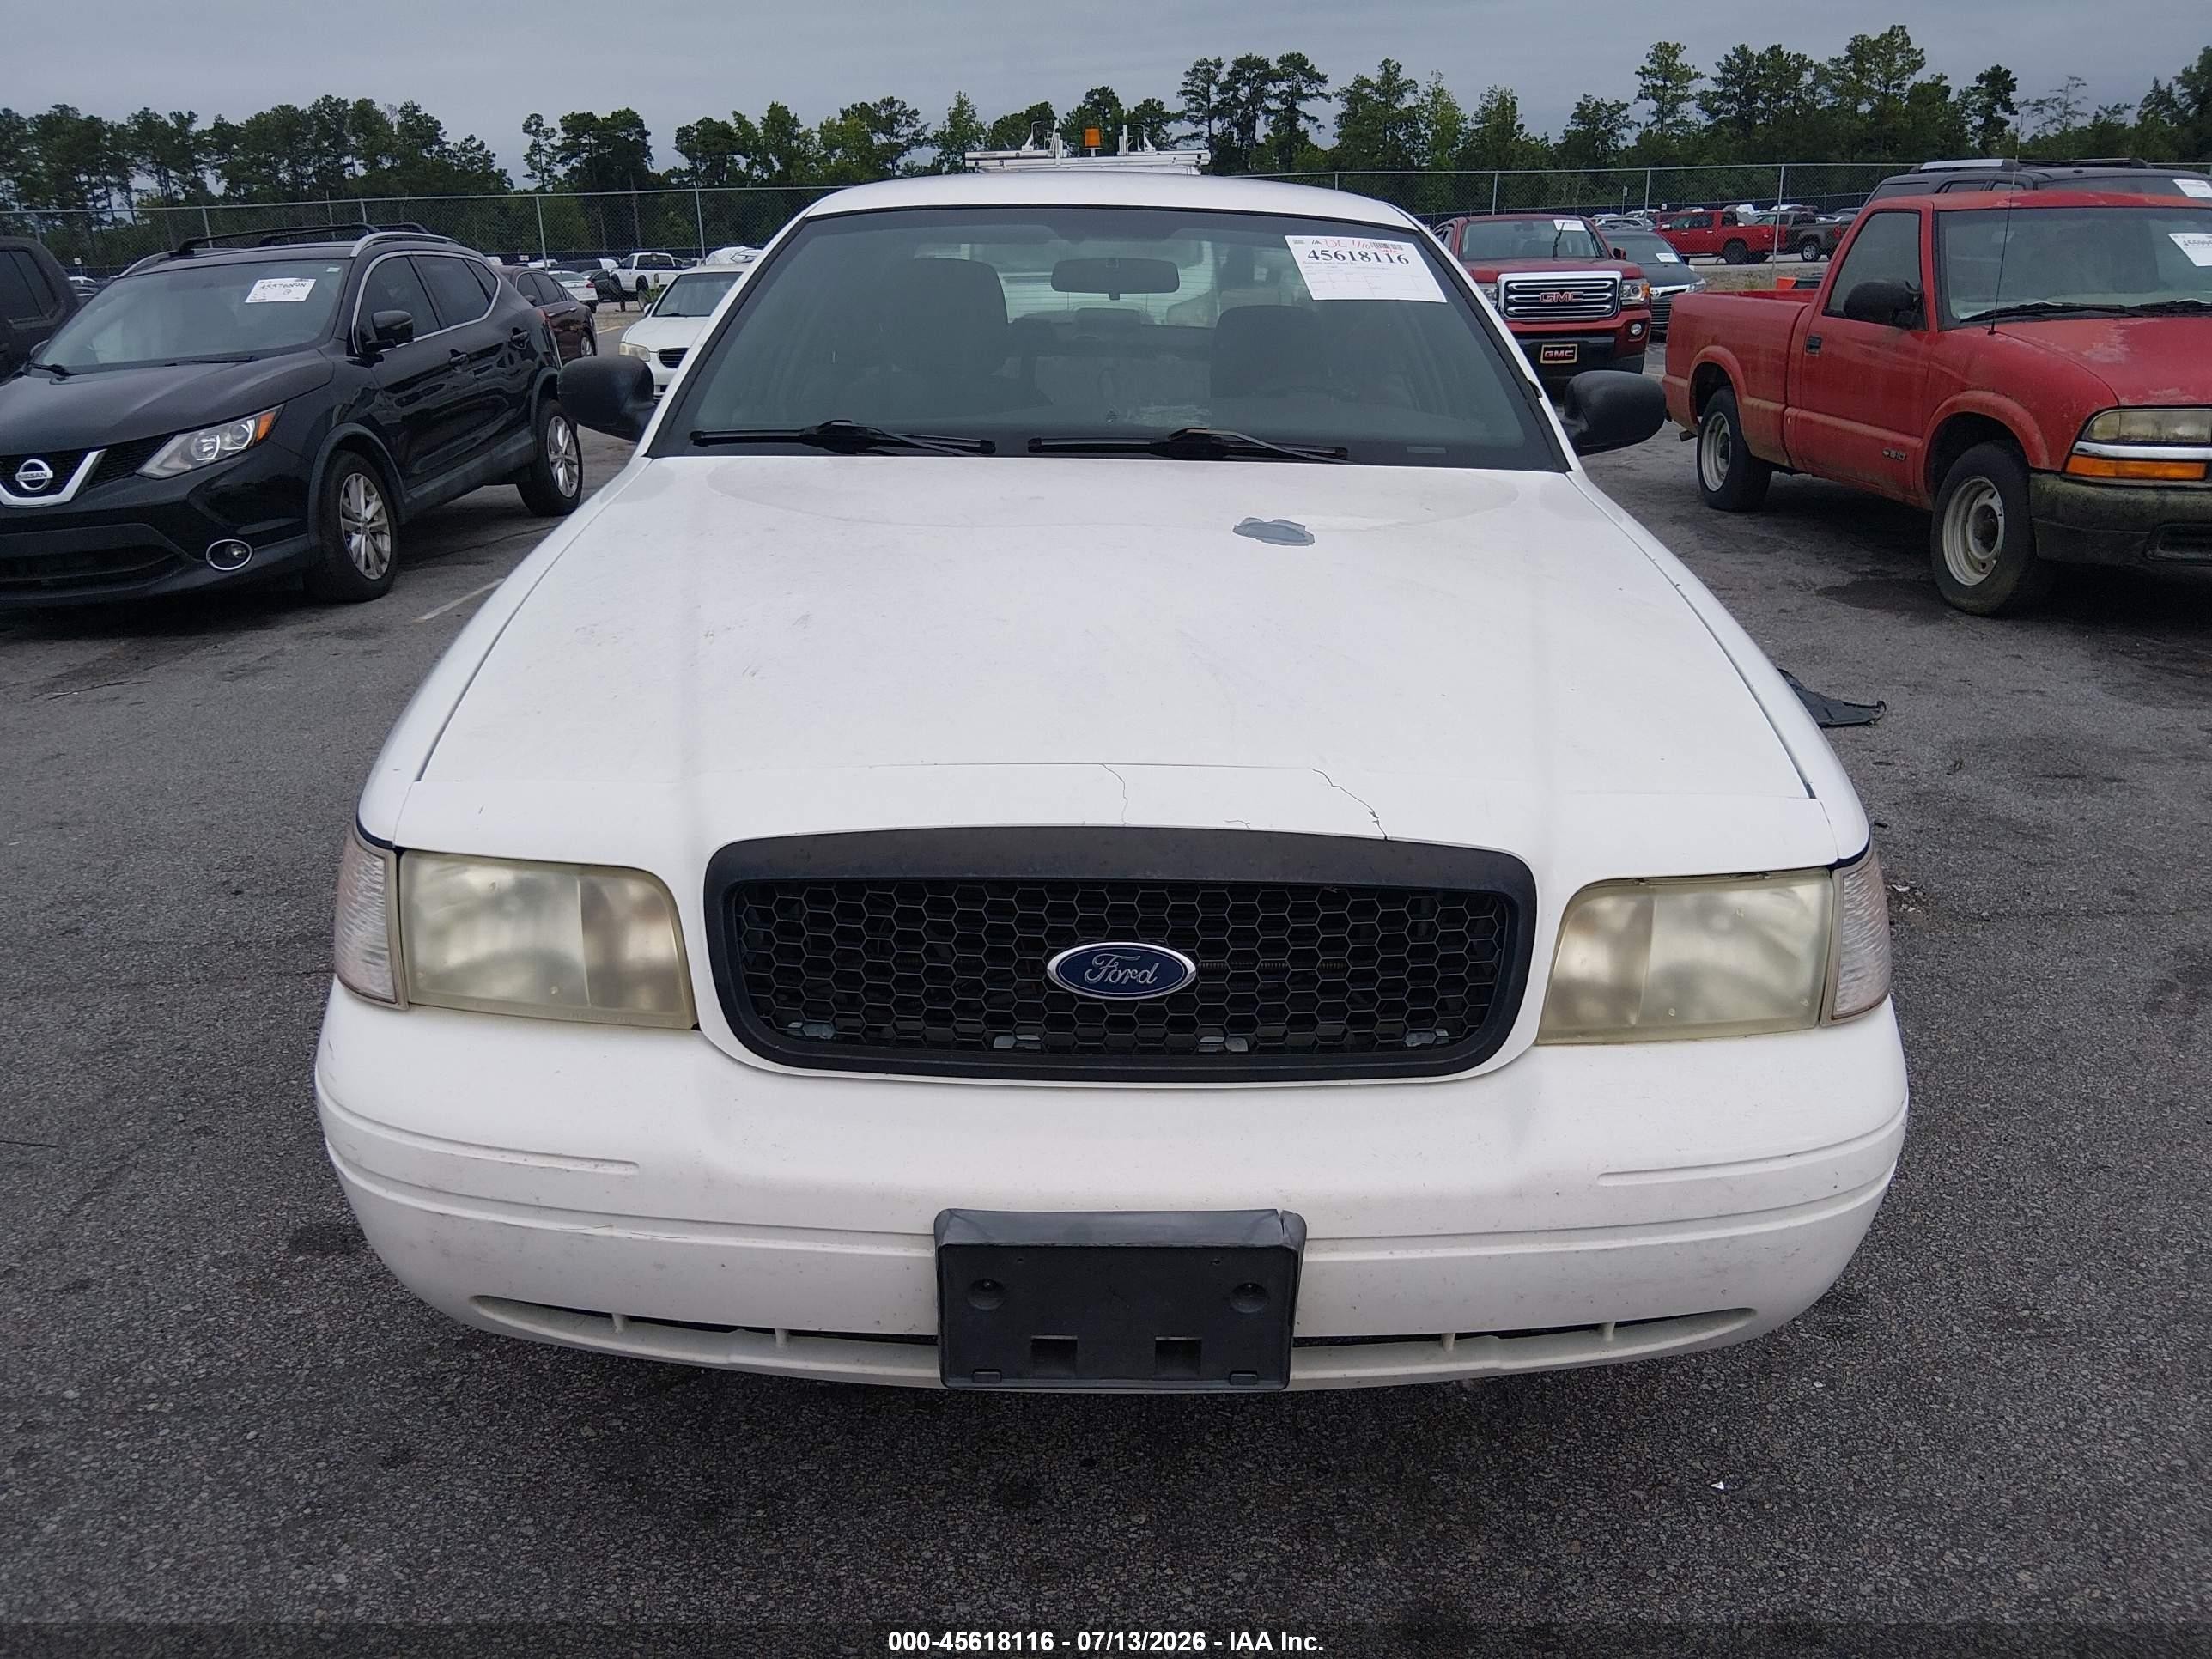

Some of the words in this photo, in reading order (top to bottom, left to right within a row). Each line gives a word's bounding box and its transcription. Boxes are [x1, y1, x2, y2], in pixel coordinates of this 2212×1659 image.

[1307, 249, 1409, 264] 45618116
[1539, 291, 1584, 303] GMC
[1084, 953, 1159, 985] Ford
